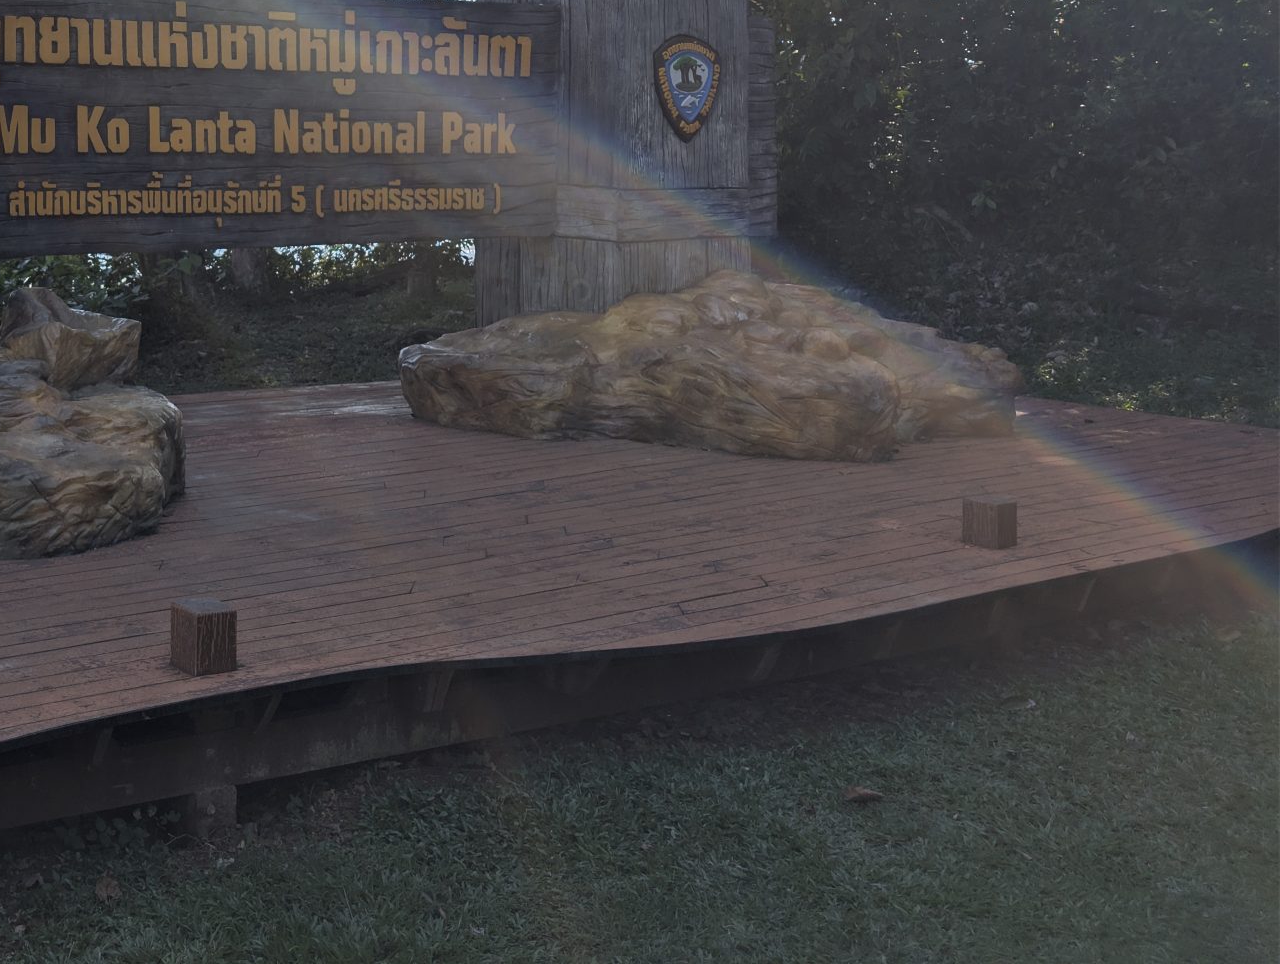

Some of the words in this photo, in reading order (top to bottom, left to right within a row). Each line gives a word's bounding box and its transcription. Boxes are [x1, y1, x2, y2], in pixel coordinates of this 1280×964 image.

[76, 105, 130, 154] Ko
[148, 105, 257, 155] Lanta
[273, 108, 426, 155] National
[442, 111, 518, 155] Park
[291, 185, 307, 214] 5
